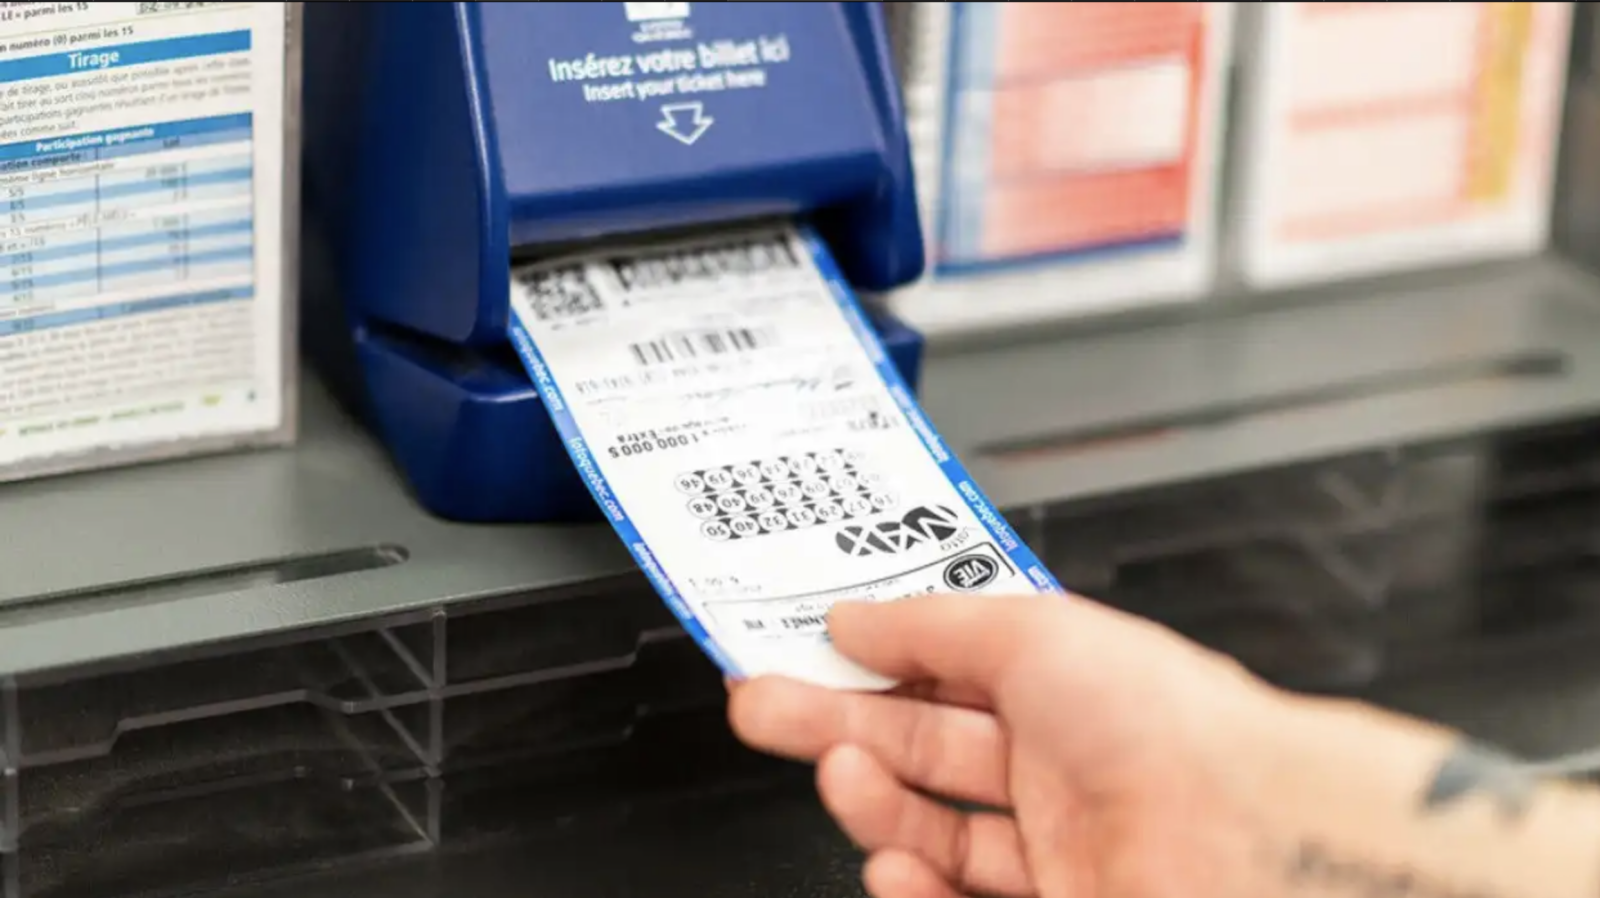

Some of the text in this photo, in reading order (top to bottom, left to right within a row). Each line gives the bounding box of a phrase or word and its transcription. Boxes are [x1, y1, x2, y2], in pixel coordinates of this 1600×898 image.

[24, 6, 55, 19] parmi
[58, 4, 73, 13] les
[9, 37, 51, 51] numéro
[70, 30, 101, 44] parmi
[103, 27, 118, 37] les
[122, 25, 134, 36] 15
[67, 50, 120, 70] Tirage
[548, 33, 791, 82] Insérez votre billet ici
[582, 69, 768, 102] Insert your ticket here
[36, 133, 103, 152] Participation
[31, 152, 81, 167] comporte
[617, 430, 658, 445] Extra
[657, 433, 689, 449] 000
[620, 440, 654, 456] 000
[680, 478, 701, 490] 46
[693, 502, 714, 513] 48
[721, 497, 741, 508] 40
[791, 509, 810, 522] 31
[818, 505, 837, 518] 29
[958, 480, 1020, 552] lotoquebec.com
[735, 520, 755, 532] 40
[763, 514, 781, 527] 32
[706, 525, 727, 537] 50
[835, 505, 959, 556] MAX
[950, 560, 993, 588] VIE
